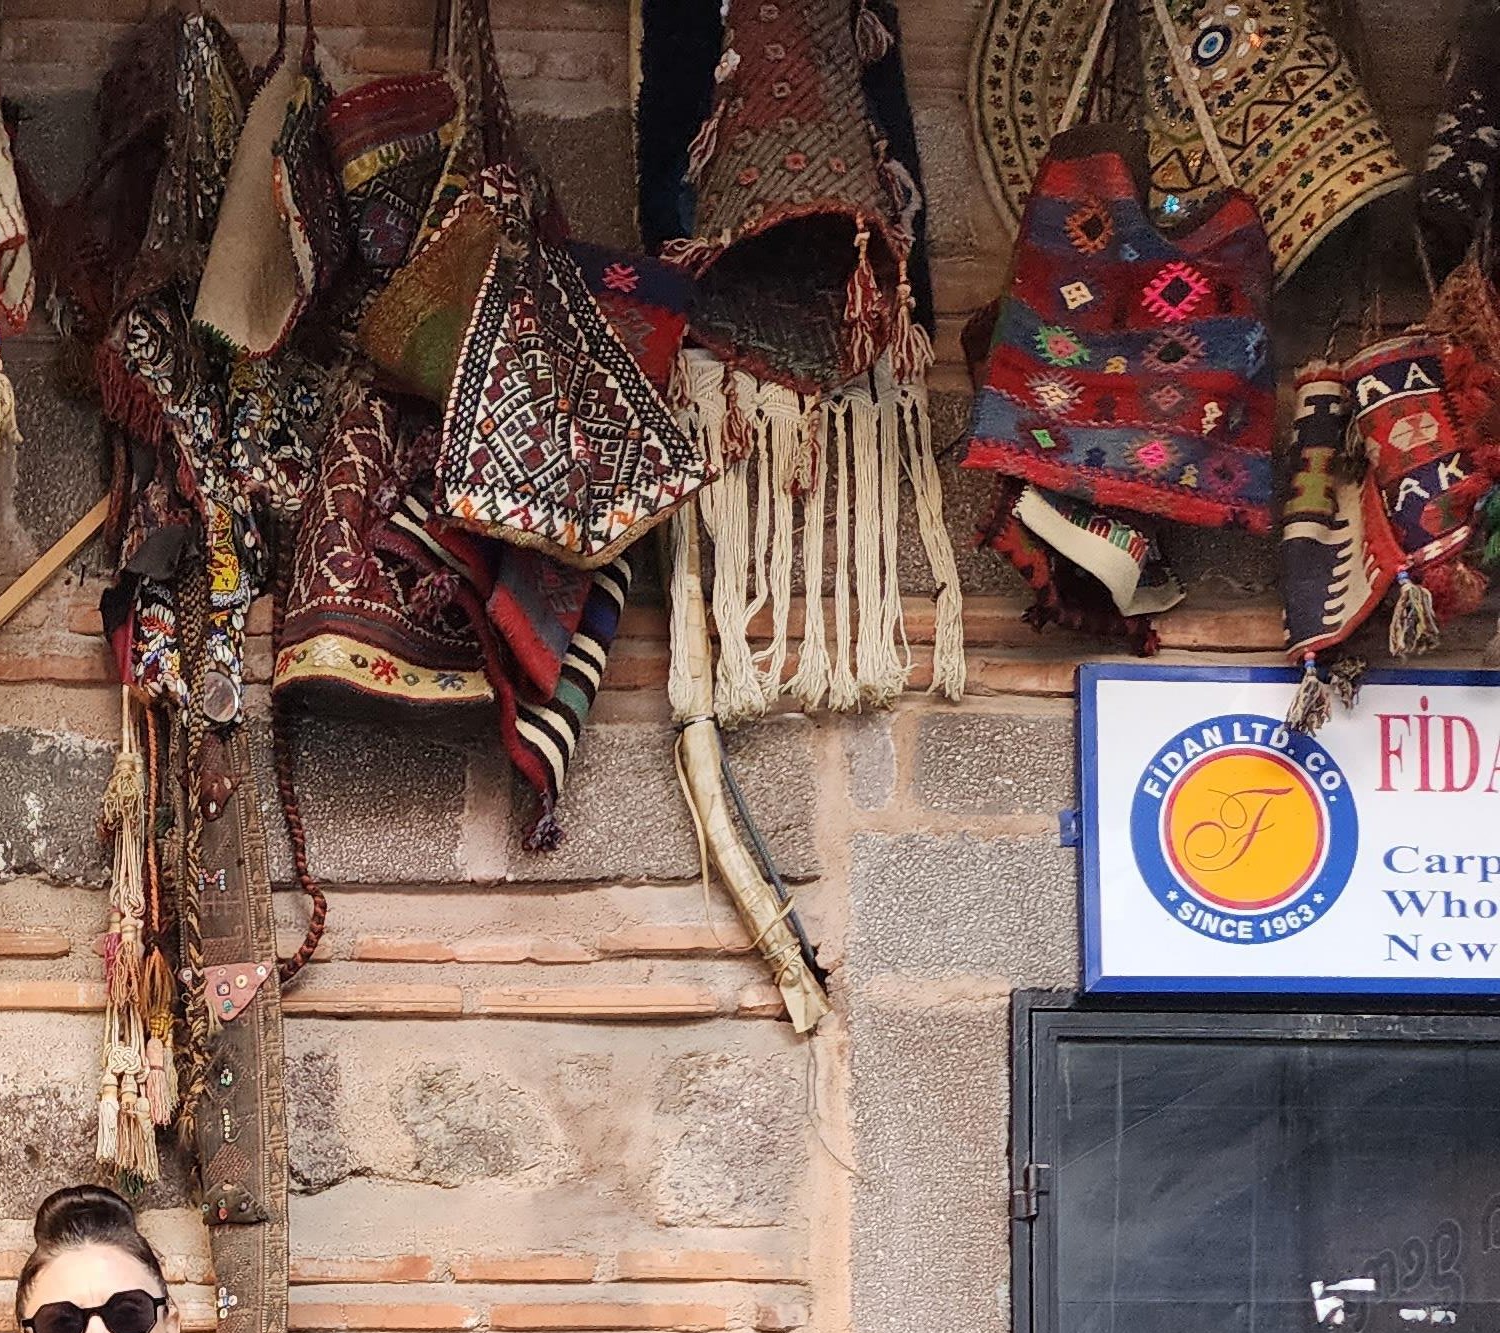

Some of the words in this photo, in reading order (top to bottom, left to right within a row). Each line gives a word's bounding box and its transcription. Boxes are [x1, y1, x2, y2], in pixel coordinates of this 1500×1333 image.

[1233, 722, 1295, 755] LTD.
[1305, 752, 1342, 802] CO.
[1177, 902, 1253, 939] SINCE
[1260, 904, 1315, 938] 1963
[1381, 889, 1498, 919] Who
[1383, 934, 1497, 962] New
